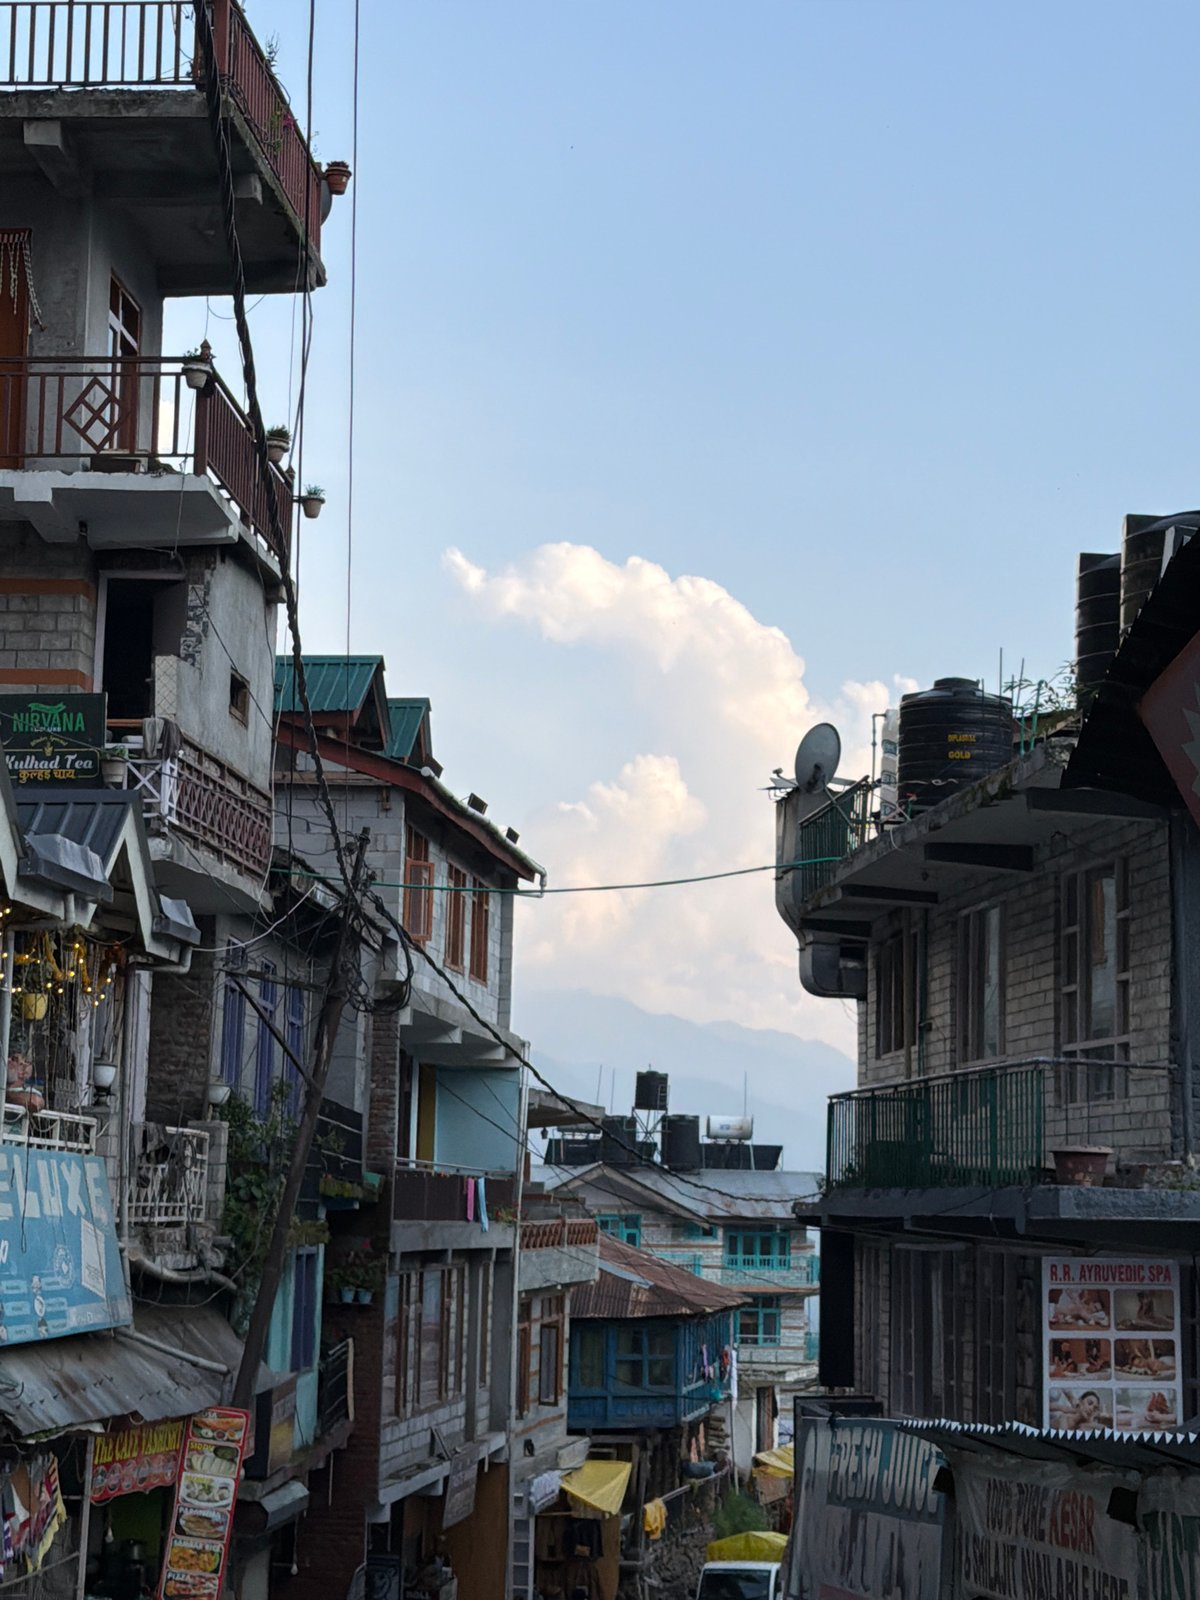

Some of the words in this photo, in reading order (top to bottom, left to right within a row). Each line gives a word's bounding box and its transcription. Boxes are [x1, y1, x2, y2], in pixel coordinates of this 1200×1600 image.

[12, 711, 86, 732] NIRVANA
[65, 753, 94, 769] Tea
[948, 751, 971, 759] GOLD
[53, 769, 76, 779] चाय
[1050, 1263, 1075, 1282] R.R.
[1079, 1263, 1146, 1282] AYRUVEDIC
[1148, 1264, 1172, 1282] SPA
[829, 1427, 882, 1500] FRESH
[881, 1430, 944, 1513] JUICE
[1049, 1489, 1096, 1556] KESAR
[1021, 1546, 1089, 1600] AVAILABLE
